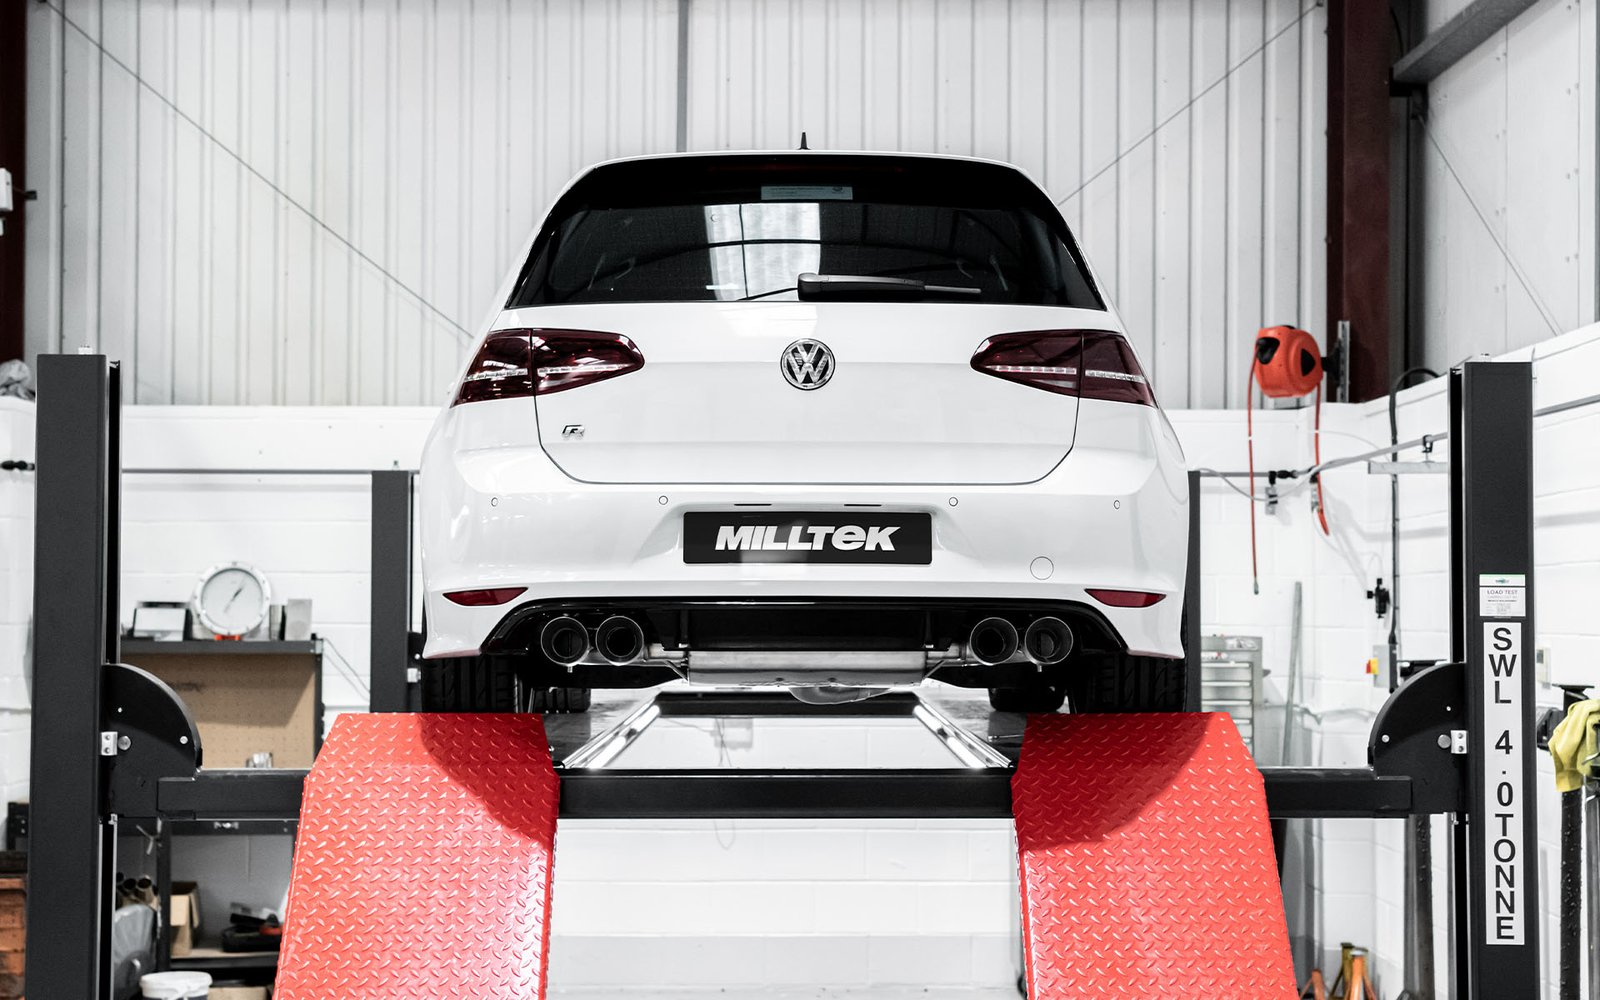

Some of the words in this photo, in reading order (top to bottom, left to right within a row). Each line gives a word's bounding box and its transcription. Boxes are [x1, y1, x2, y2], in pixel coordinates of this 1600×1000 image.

[783, 340, 833, 388] VW
[1488, 627, 1517, 704] SWL
[1493, 813, 1516, 940] TONNE
